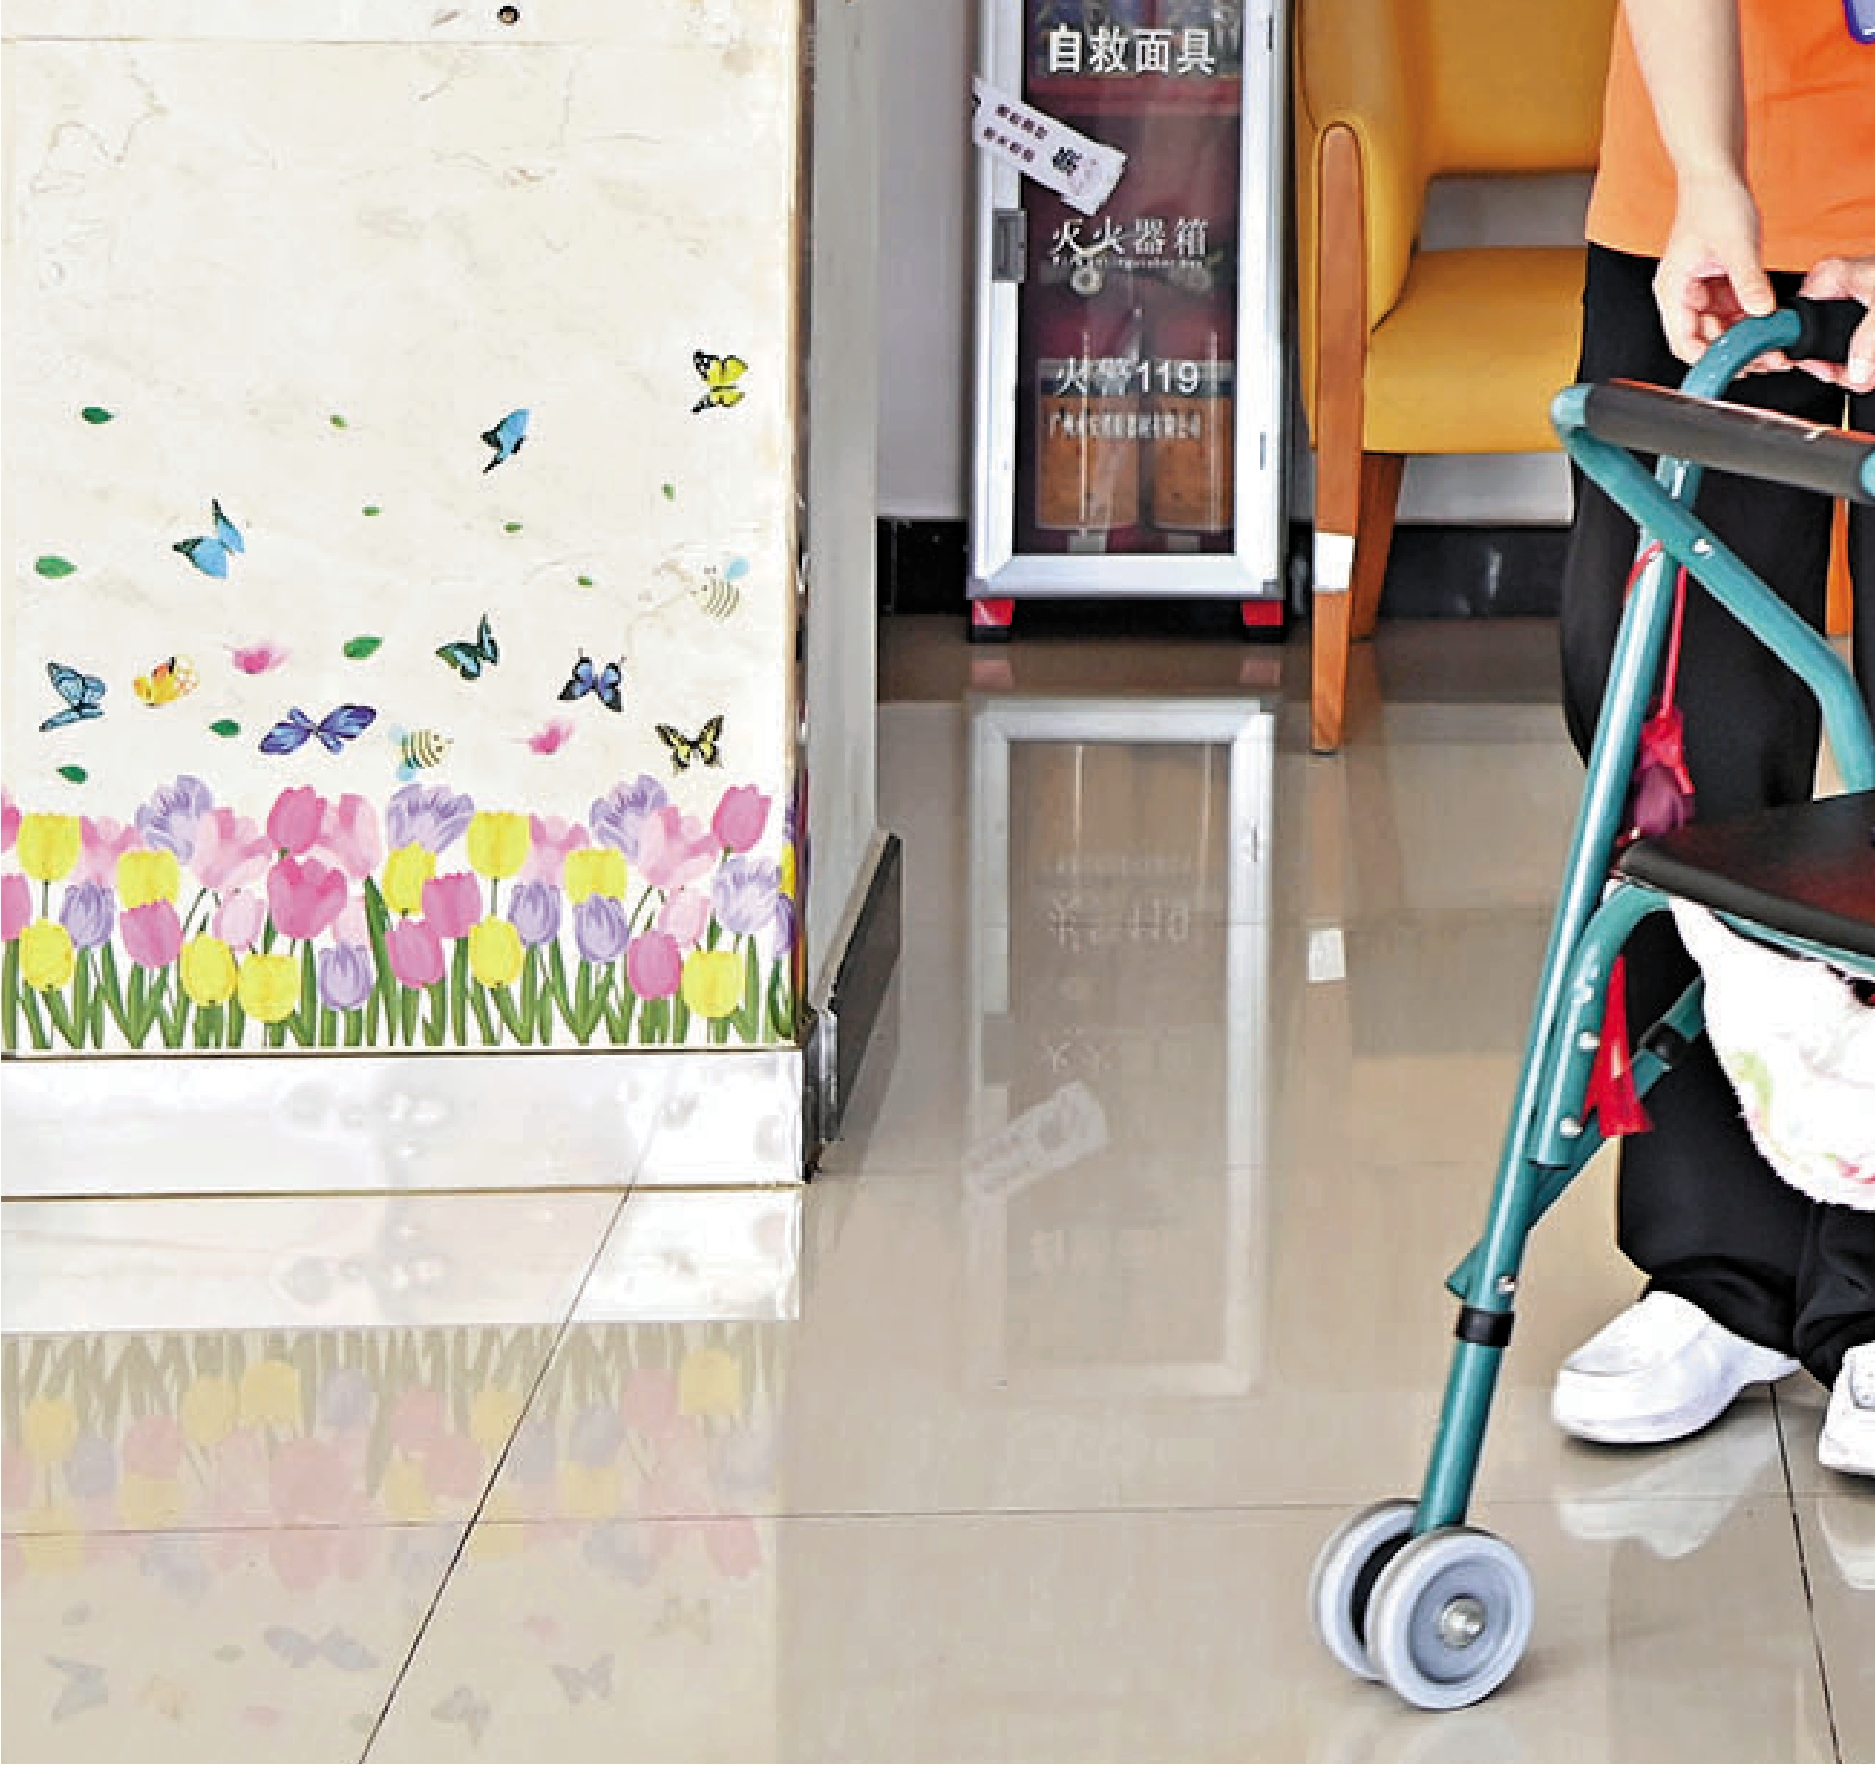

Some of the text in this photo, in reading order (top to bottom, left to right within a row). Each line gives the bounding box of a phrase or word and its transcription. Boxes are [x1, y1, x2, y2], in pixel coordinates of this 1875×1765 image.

[1050, 23, 1214, 73] 自救面具
[1047, 216, 1208, 257] 灭火器箱
